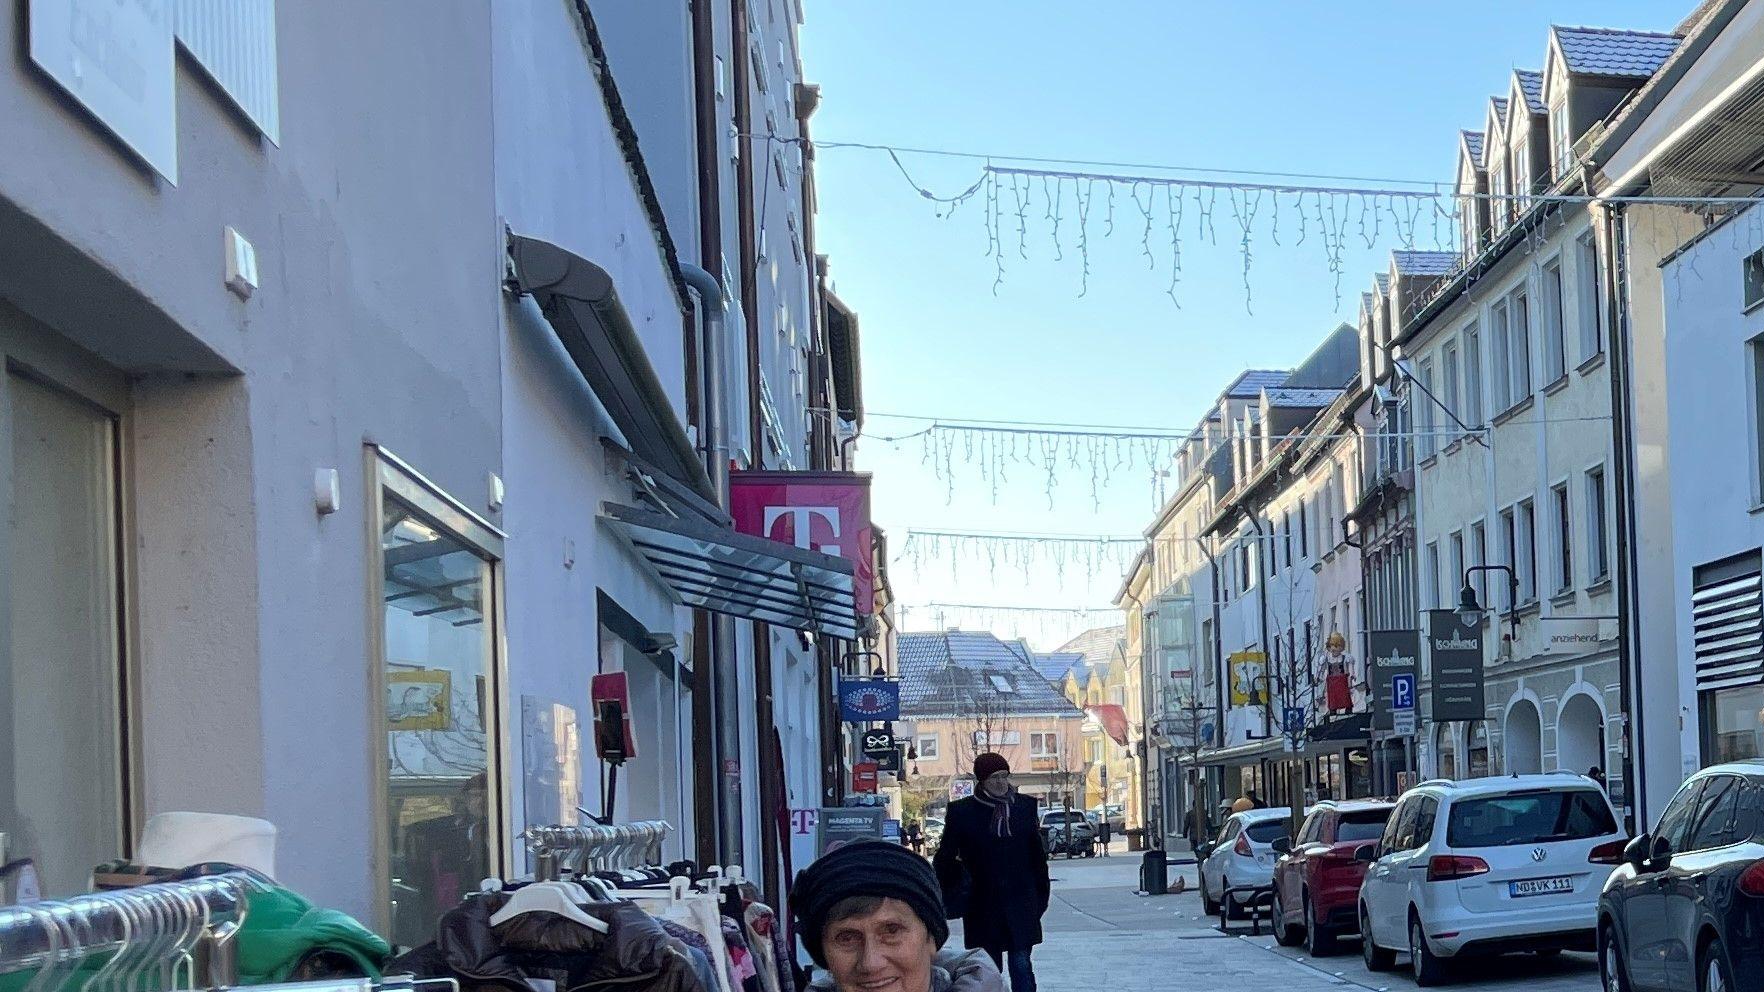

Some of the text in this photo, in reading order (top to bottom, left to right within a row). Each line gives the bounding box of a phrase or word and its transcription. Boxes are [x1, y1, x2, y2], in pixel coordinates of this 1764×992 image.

[1396, 679, 1409, 706] P
[791, 809, 815, 835] T
[1516, 882, 1531, 893] ND
[1552, 877, 1572, 889] 111
